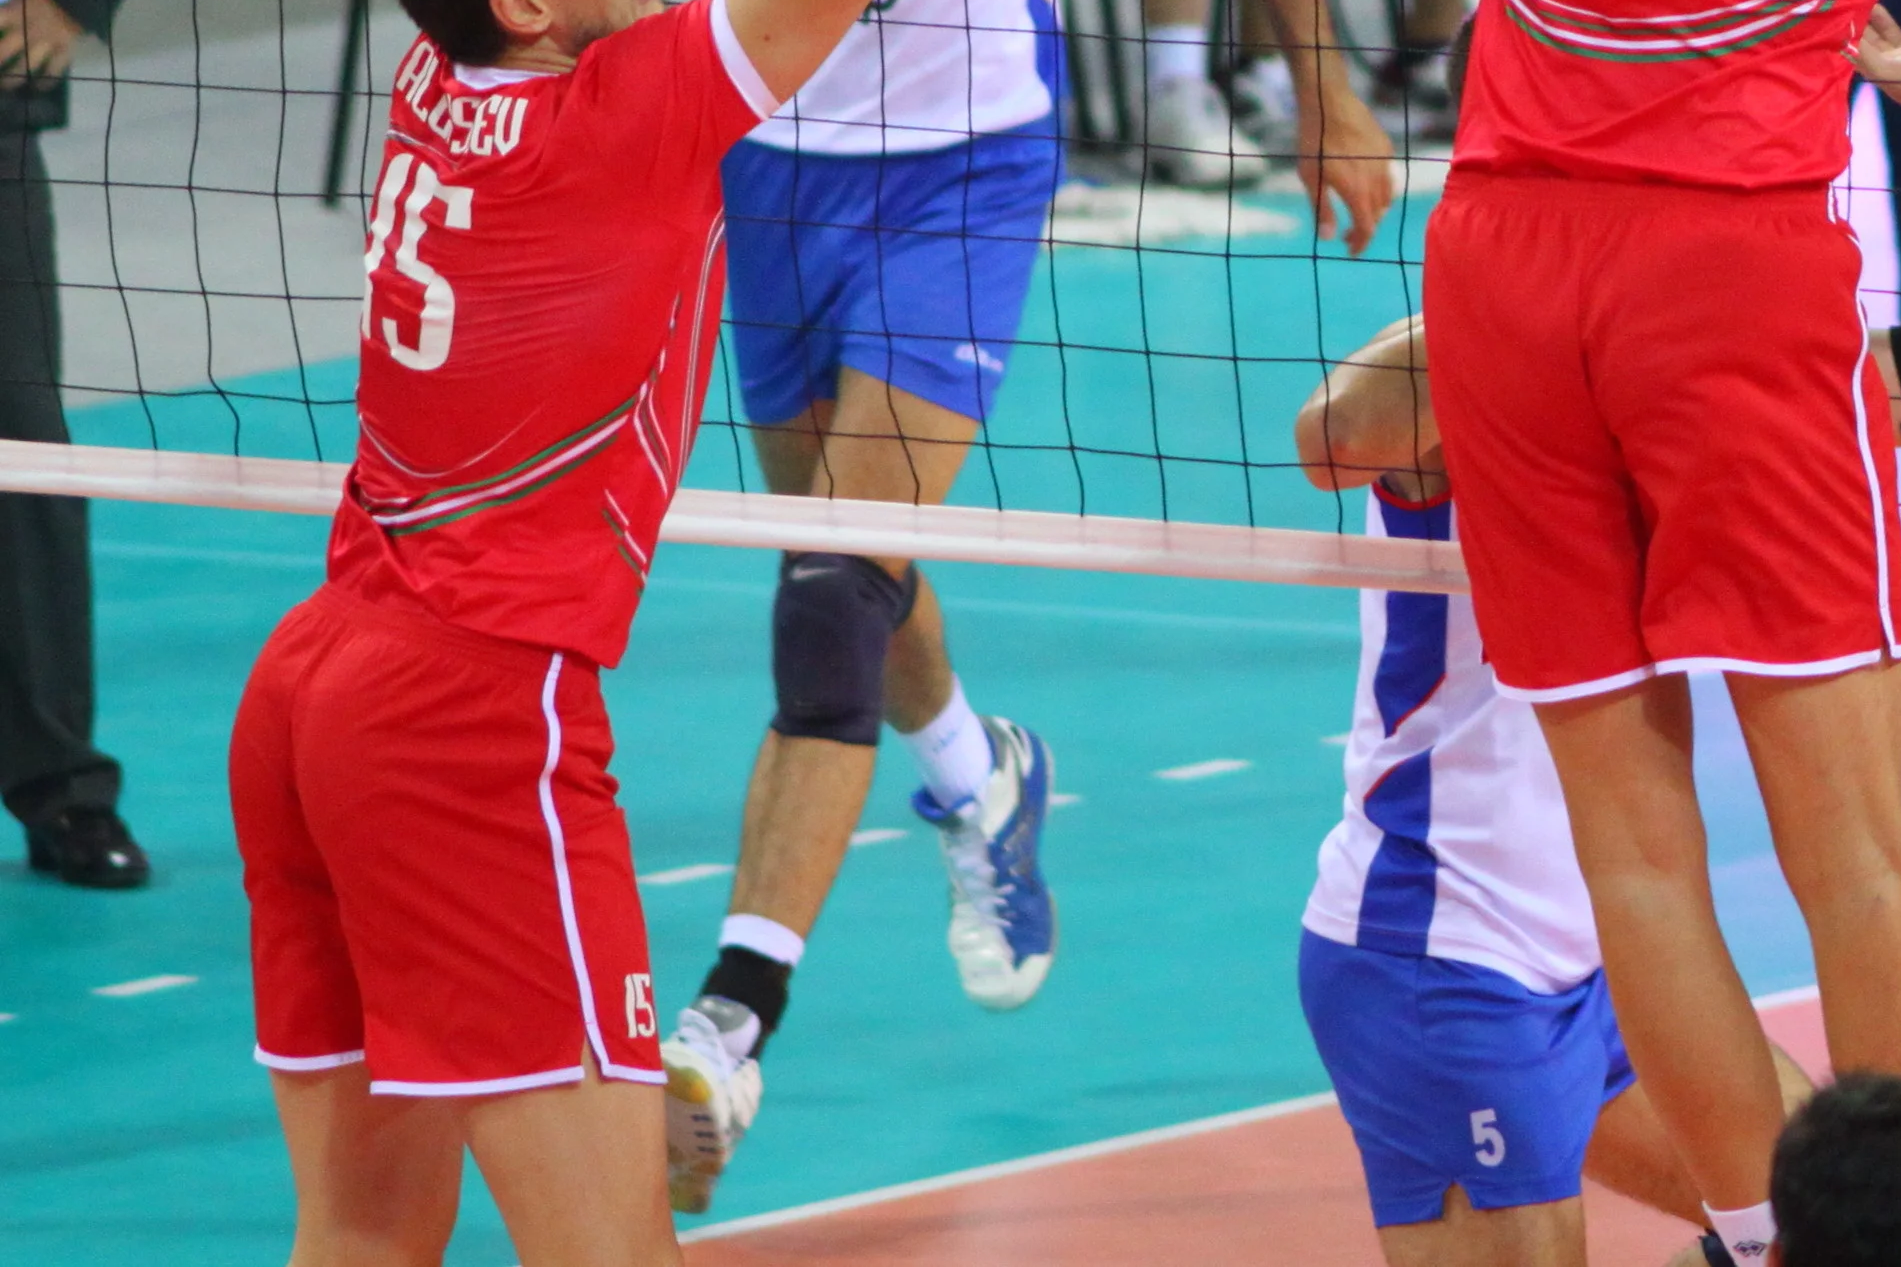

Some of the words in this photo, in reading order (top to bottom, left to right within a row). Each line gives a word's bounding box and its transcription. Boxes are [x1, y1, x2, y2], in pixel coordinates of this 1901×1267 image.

[362, 153, 474, 372] 15
[624, 972, 657, 1039] 15
[1469, 1107, 1507, 1168] 5
